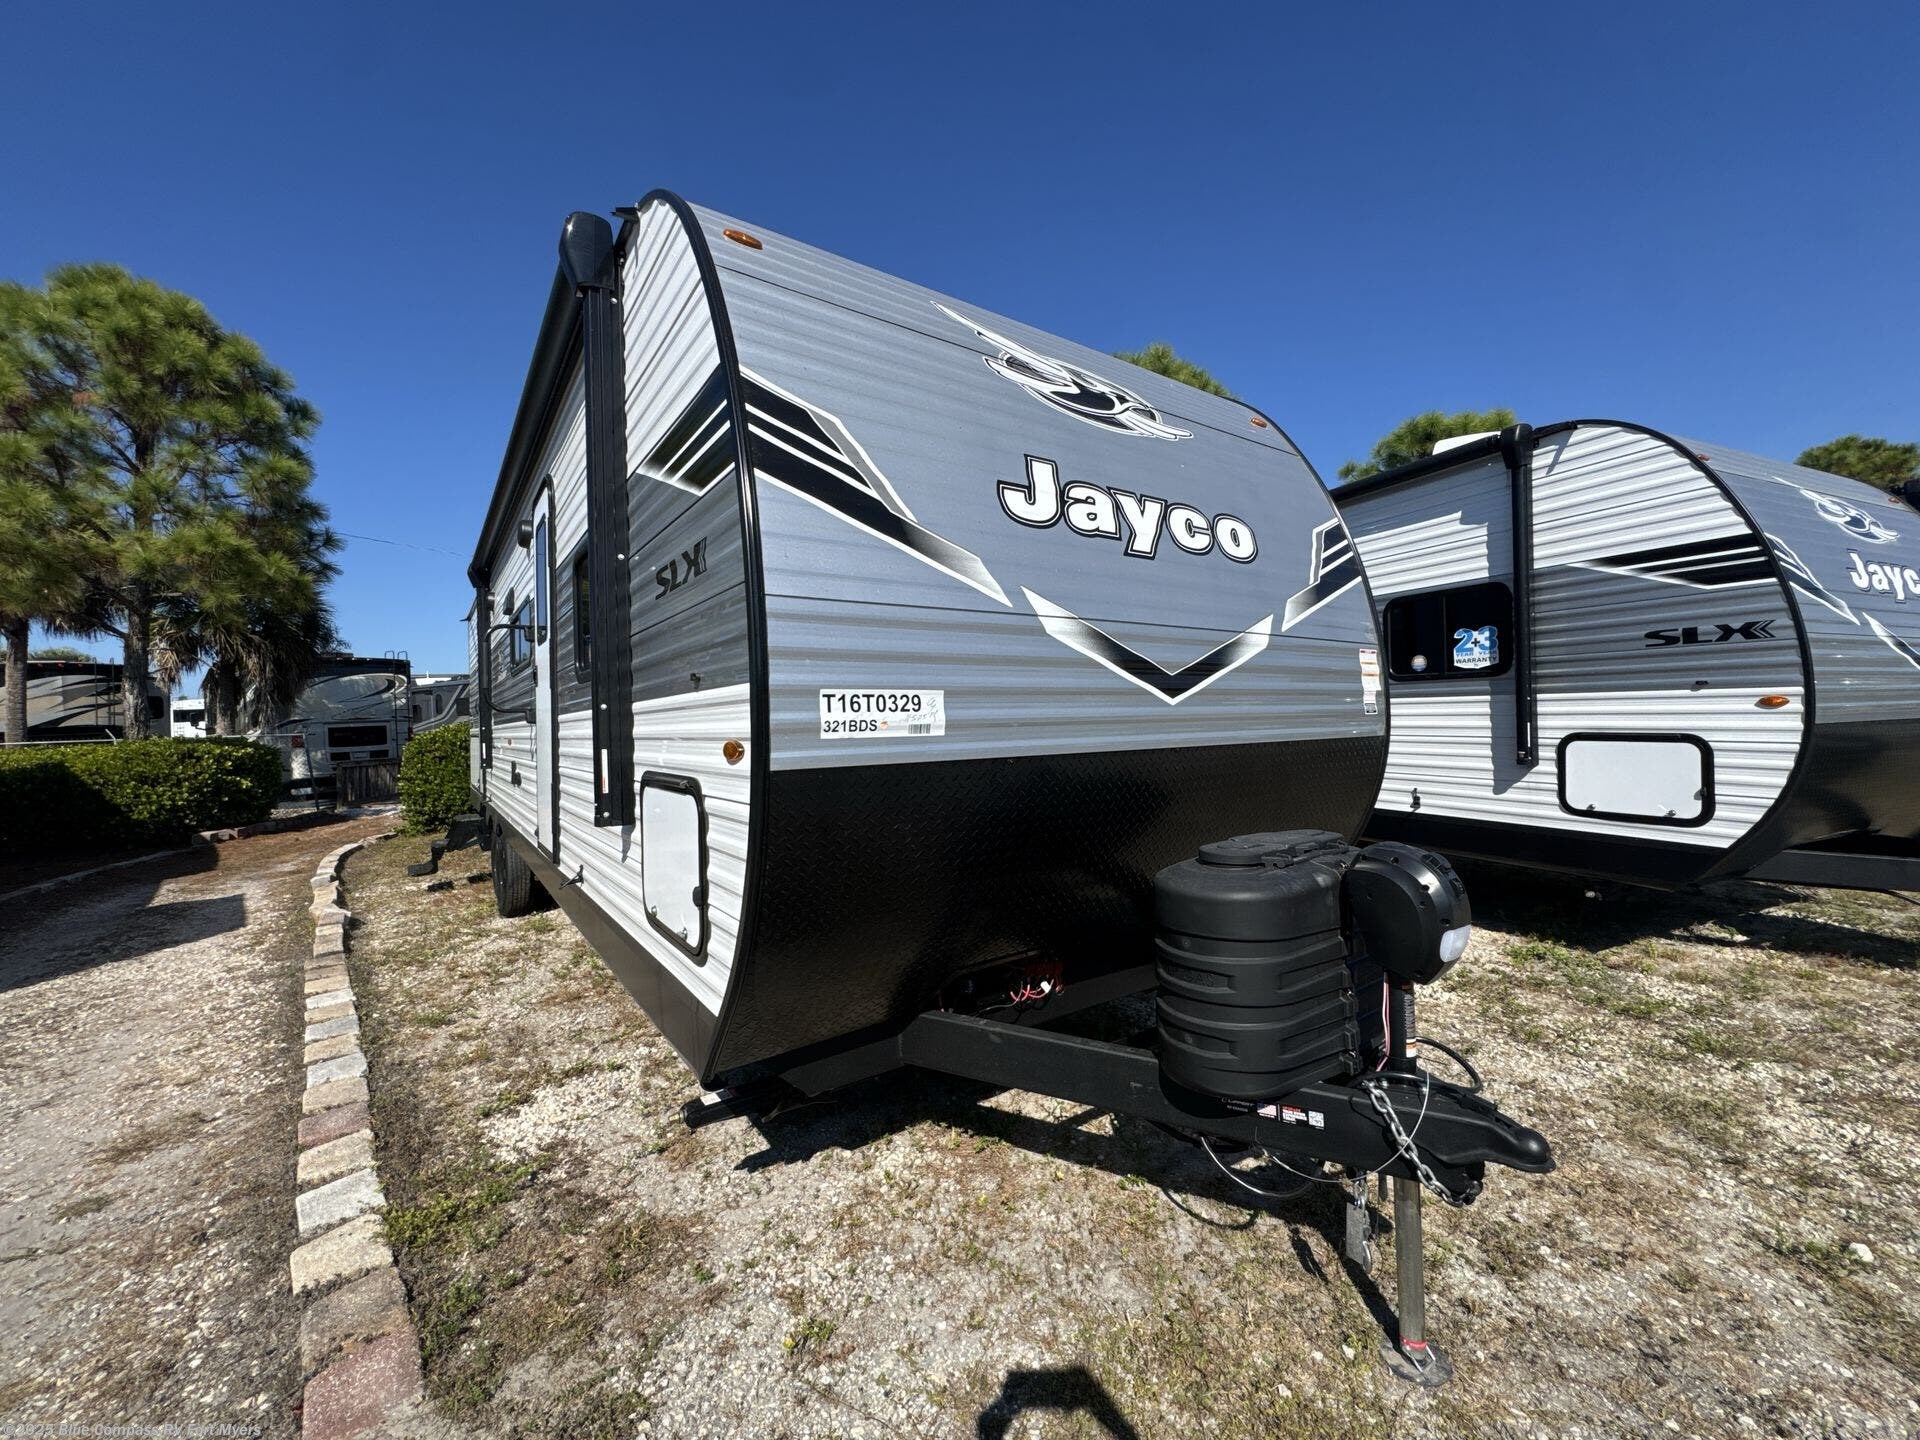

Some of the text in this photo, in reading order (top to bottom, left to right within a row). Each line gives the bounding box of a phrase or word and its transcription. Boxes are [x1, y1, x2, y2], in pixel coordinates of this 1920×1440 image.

[996, 453, 1258, 563] Jayco
[655, 536, 707, 600] SLX
[1846, 548, 1920, 603] Jayc
[1644, 619, 1776, 648] SLX
[1456, 656, 1497, 664] WARRANTY
[822, 693, 922, 713] T16T0329
[823, 719, 878, 733] 321BDS
